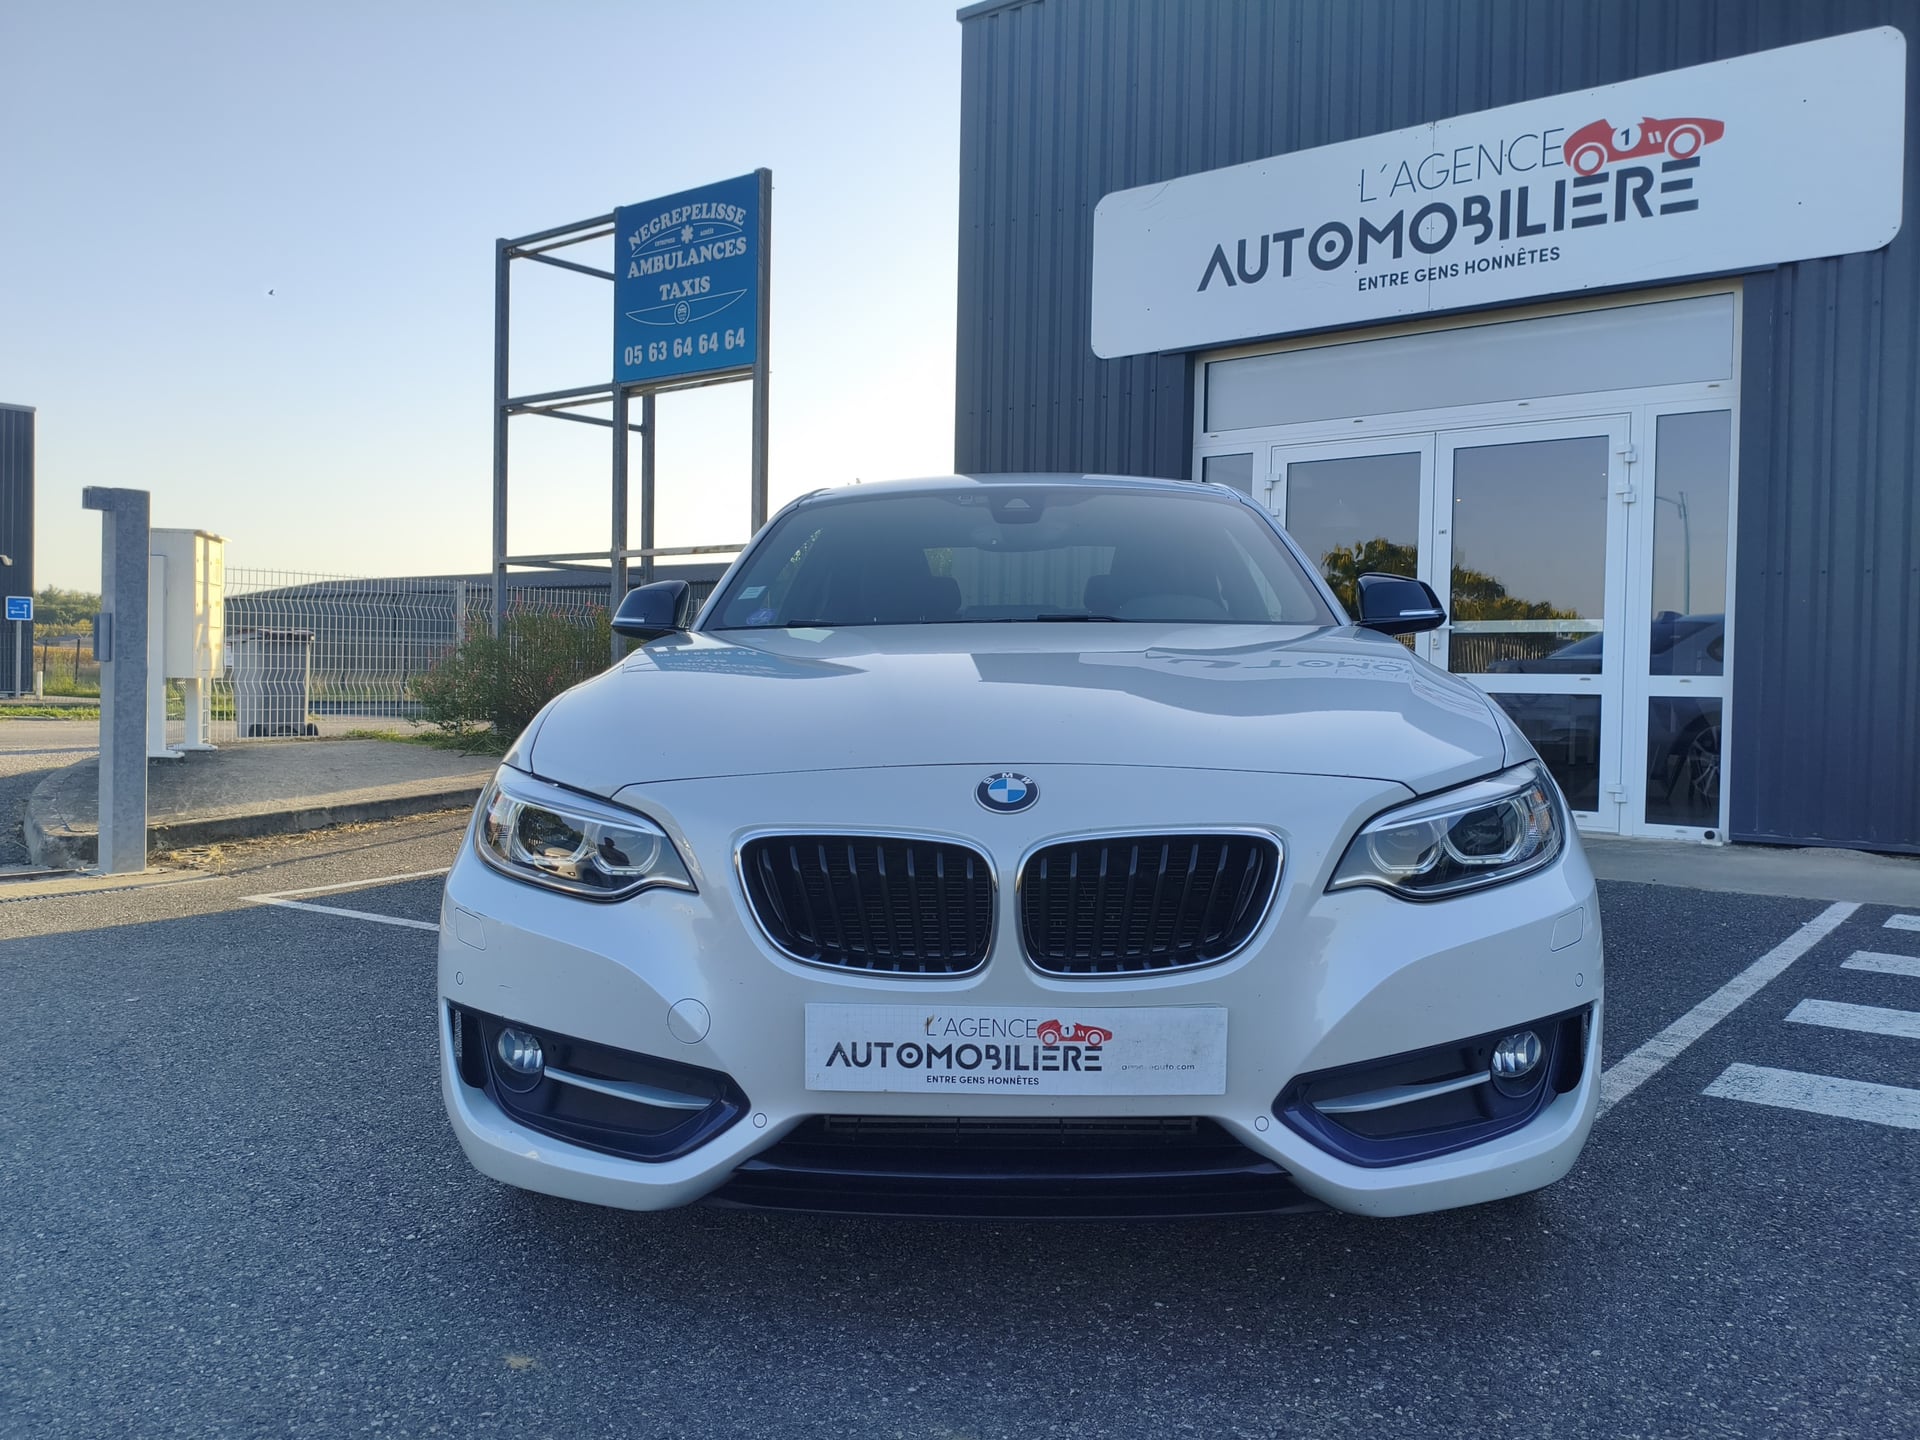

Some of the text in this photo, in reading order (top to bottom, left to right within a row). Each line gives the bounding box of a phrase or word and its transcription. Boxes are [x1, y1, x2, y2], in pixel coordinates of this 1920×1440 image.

[1619, 127, 1632, 147] 1
[1359, 127, 1566, 203] L'AGENCE
[628, 202, 747, 251] NEGREPELISSE
[1196, 156, 1701, 293] AUTOMOBILIERE
[627, 236, 747, 279] AMBULANCES
[1357, 246, 1561, 292] ENTRE GENS HONNÊTES
[659, 275, 711, 301] TAXIS
[624, 327, 745, 367] 05 63 64 64 64
[983, 772, 1033, 784] BMW
[925, 1017, 1038, 1039] L'AGENCE
[825, 1041, 1103, 1072] AUTOMOBILIERE
[926, 1075, 1040, 1085] ENTRE GENS HONNÊTES
